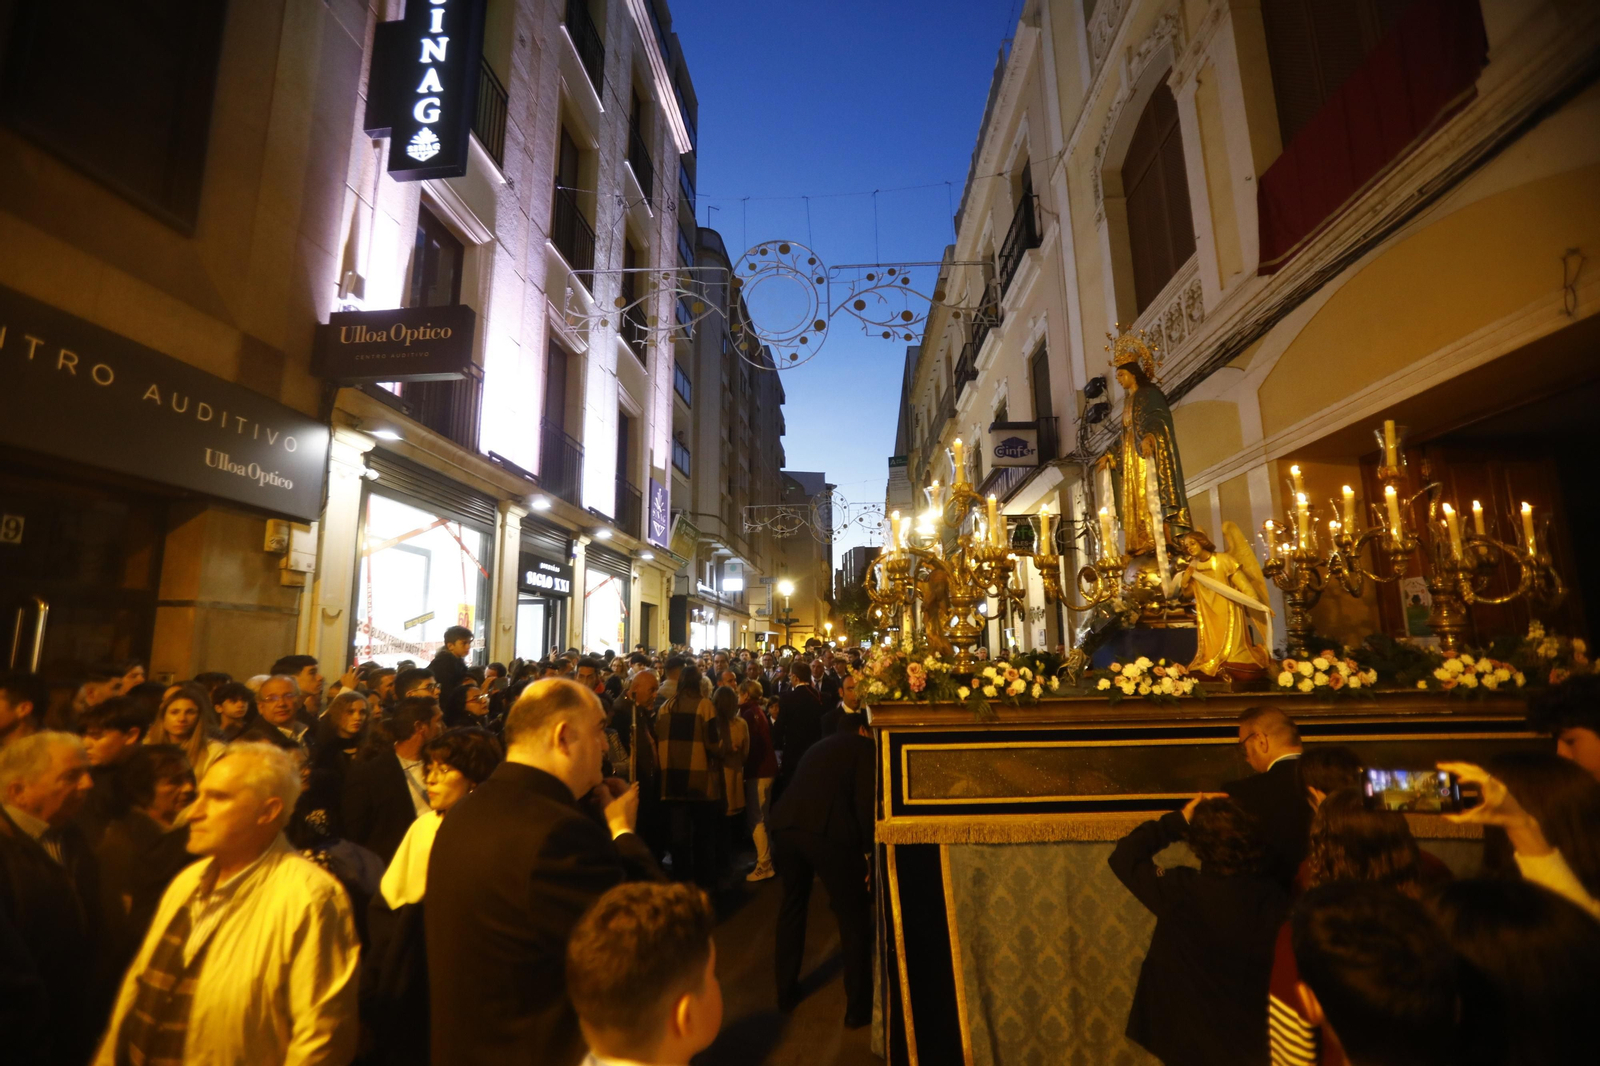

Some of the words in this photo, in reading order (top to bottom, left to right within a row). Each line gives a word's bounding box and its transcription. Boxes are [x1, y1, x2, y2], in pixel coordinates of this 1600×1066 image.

[412, 0, 451, 124] INAG
[340, 325, 387, 344] Ulloa
[390, 322, 453, 347] Optico
[355, 353, 387, 361] CENTRO
[390, 351, 430, 359] AUDITIVO
[142, 383, 298, 453] AUDITIVO
[205, 447, 246, 477] Ulloa
[247, 462, 294, 490] Optico
[526, 570, 554, 589] SIGLO
[554, 577, 570, 593] XXI
[371, 627, 389, 644] BLACK
[372, 645, 389, 655] BLACK
